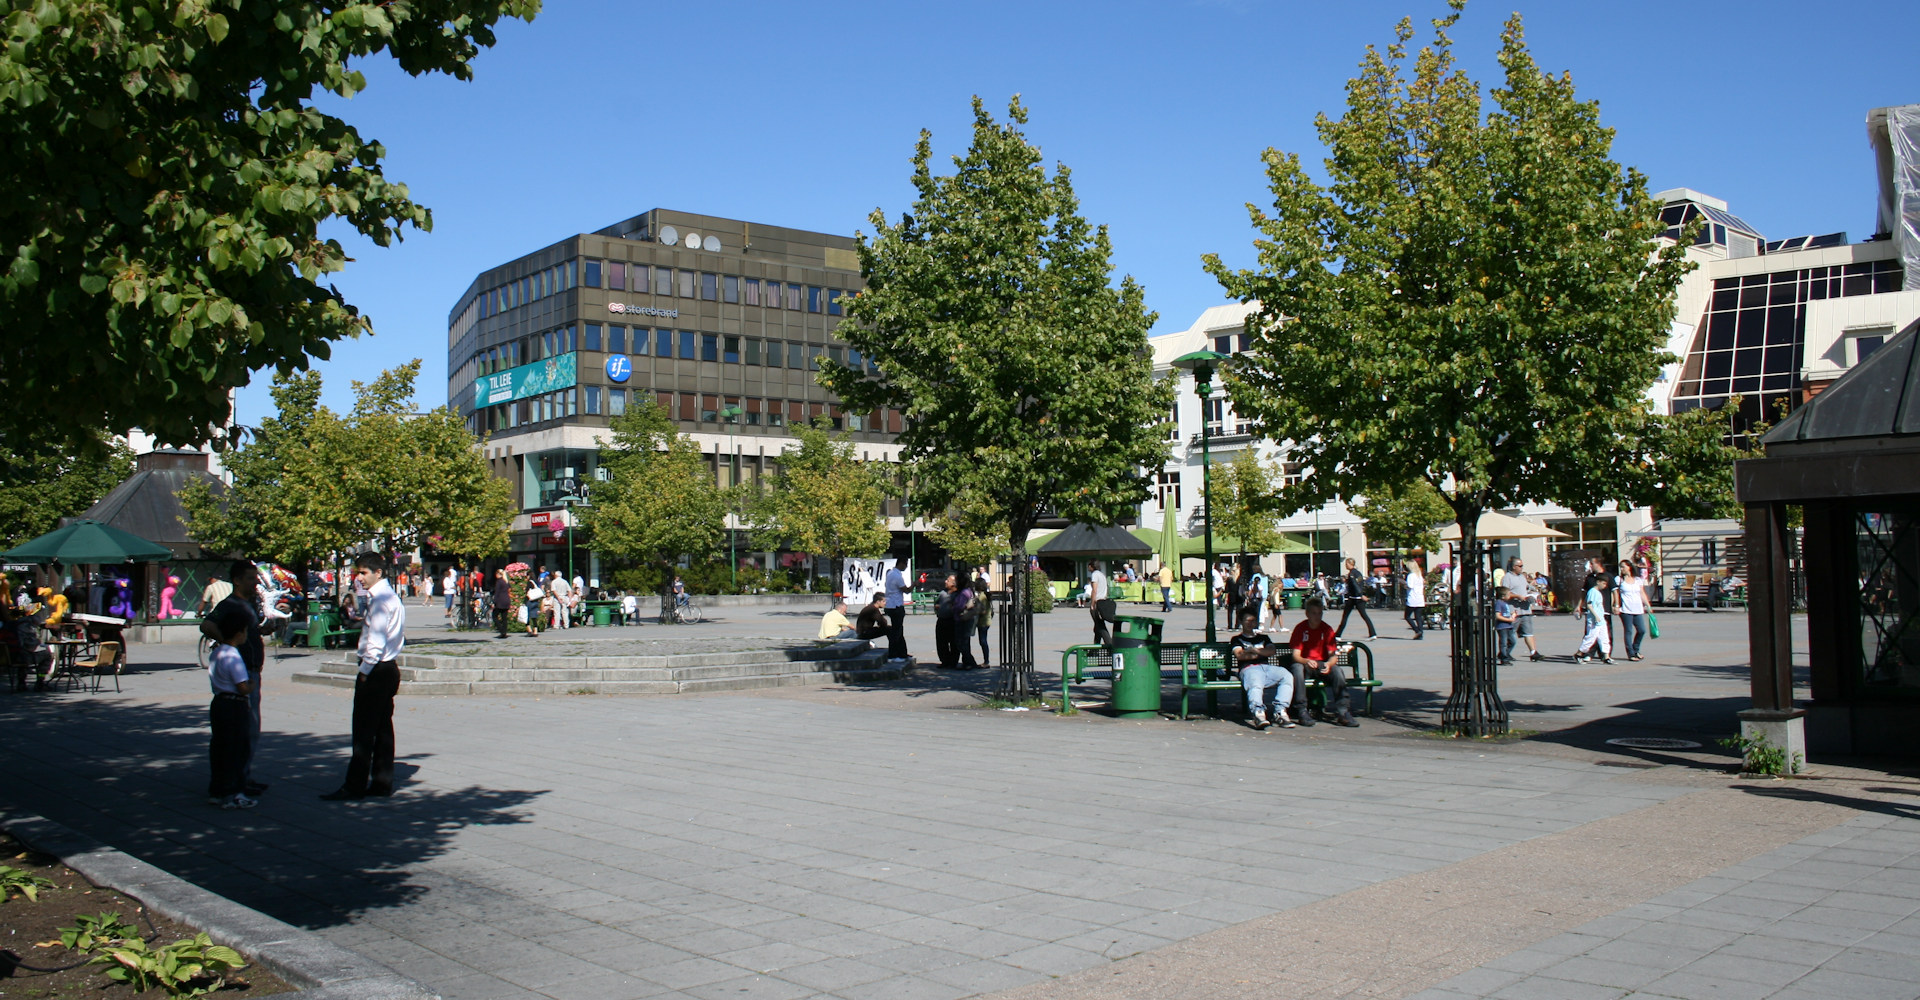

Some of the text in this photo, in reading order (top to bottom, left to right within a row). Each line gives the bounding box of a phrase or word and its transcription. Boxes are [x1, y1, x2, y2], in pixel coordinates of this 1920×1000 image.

[625, 304, 678, 318] storebrand
[489, 376, 499, 390] TIL
[499, 372, 512, 388] LEIE
